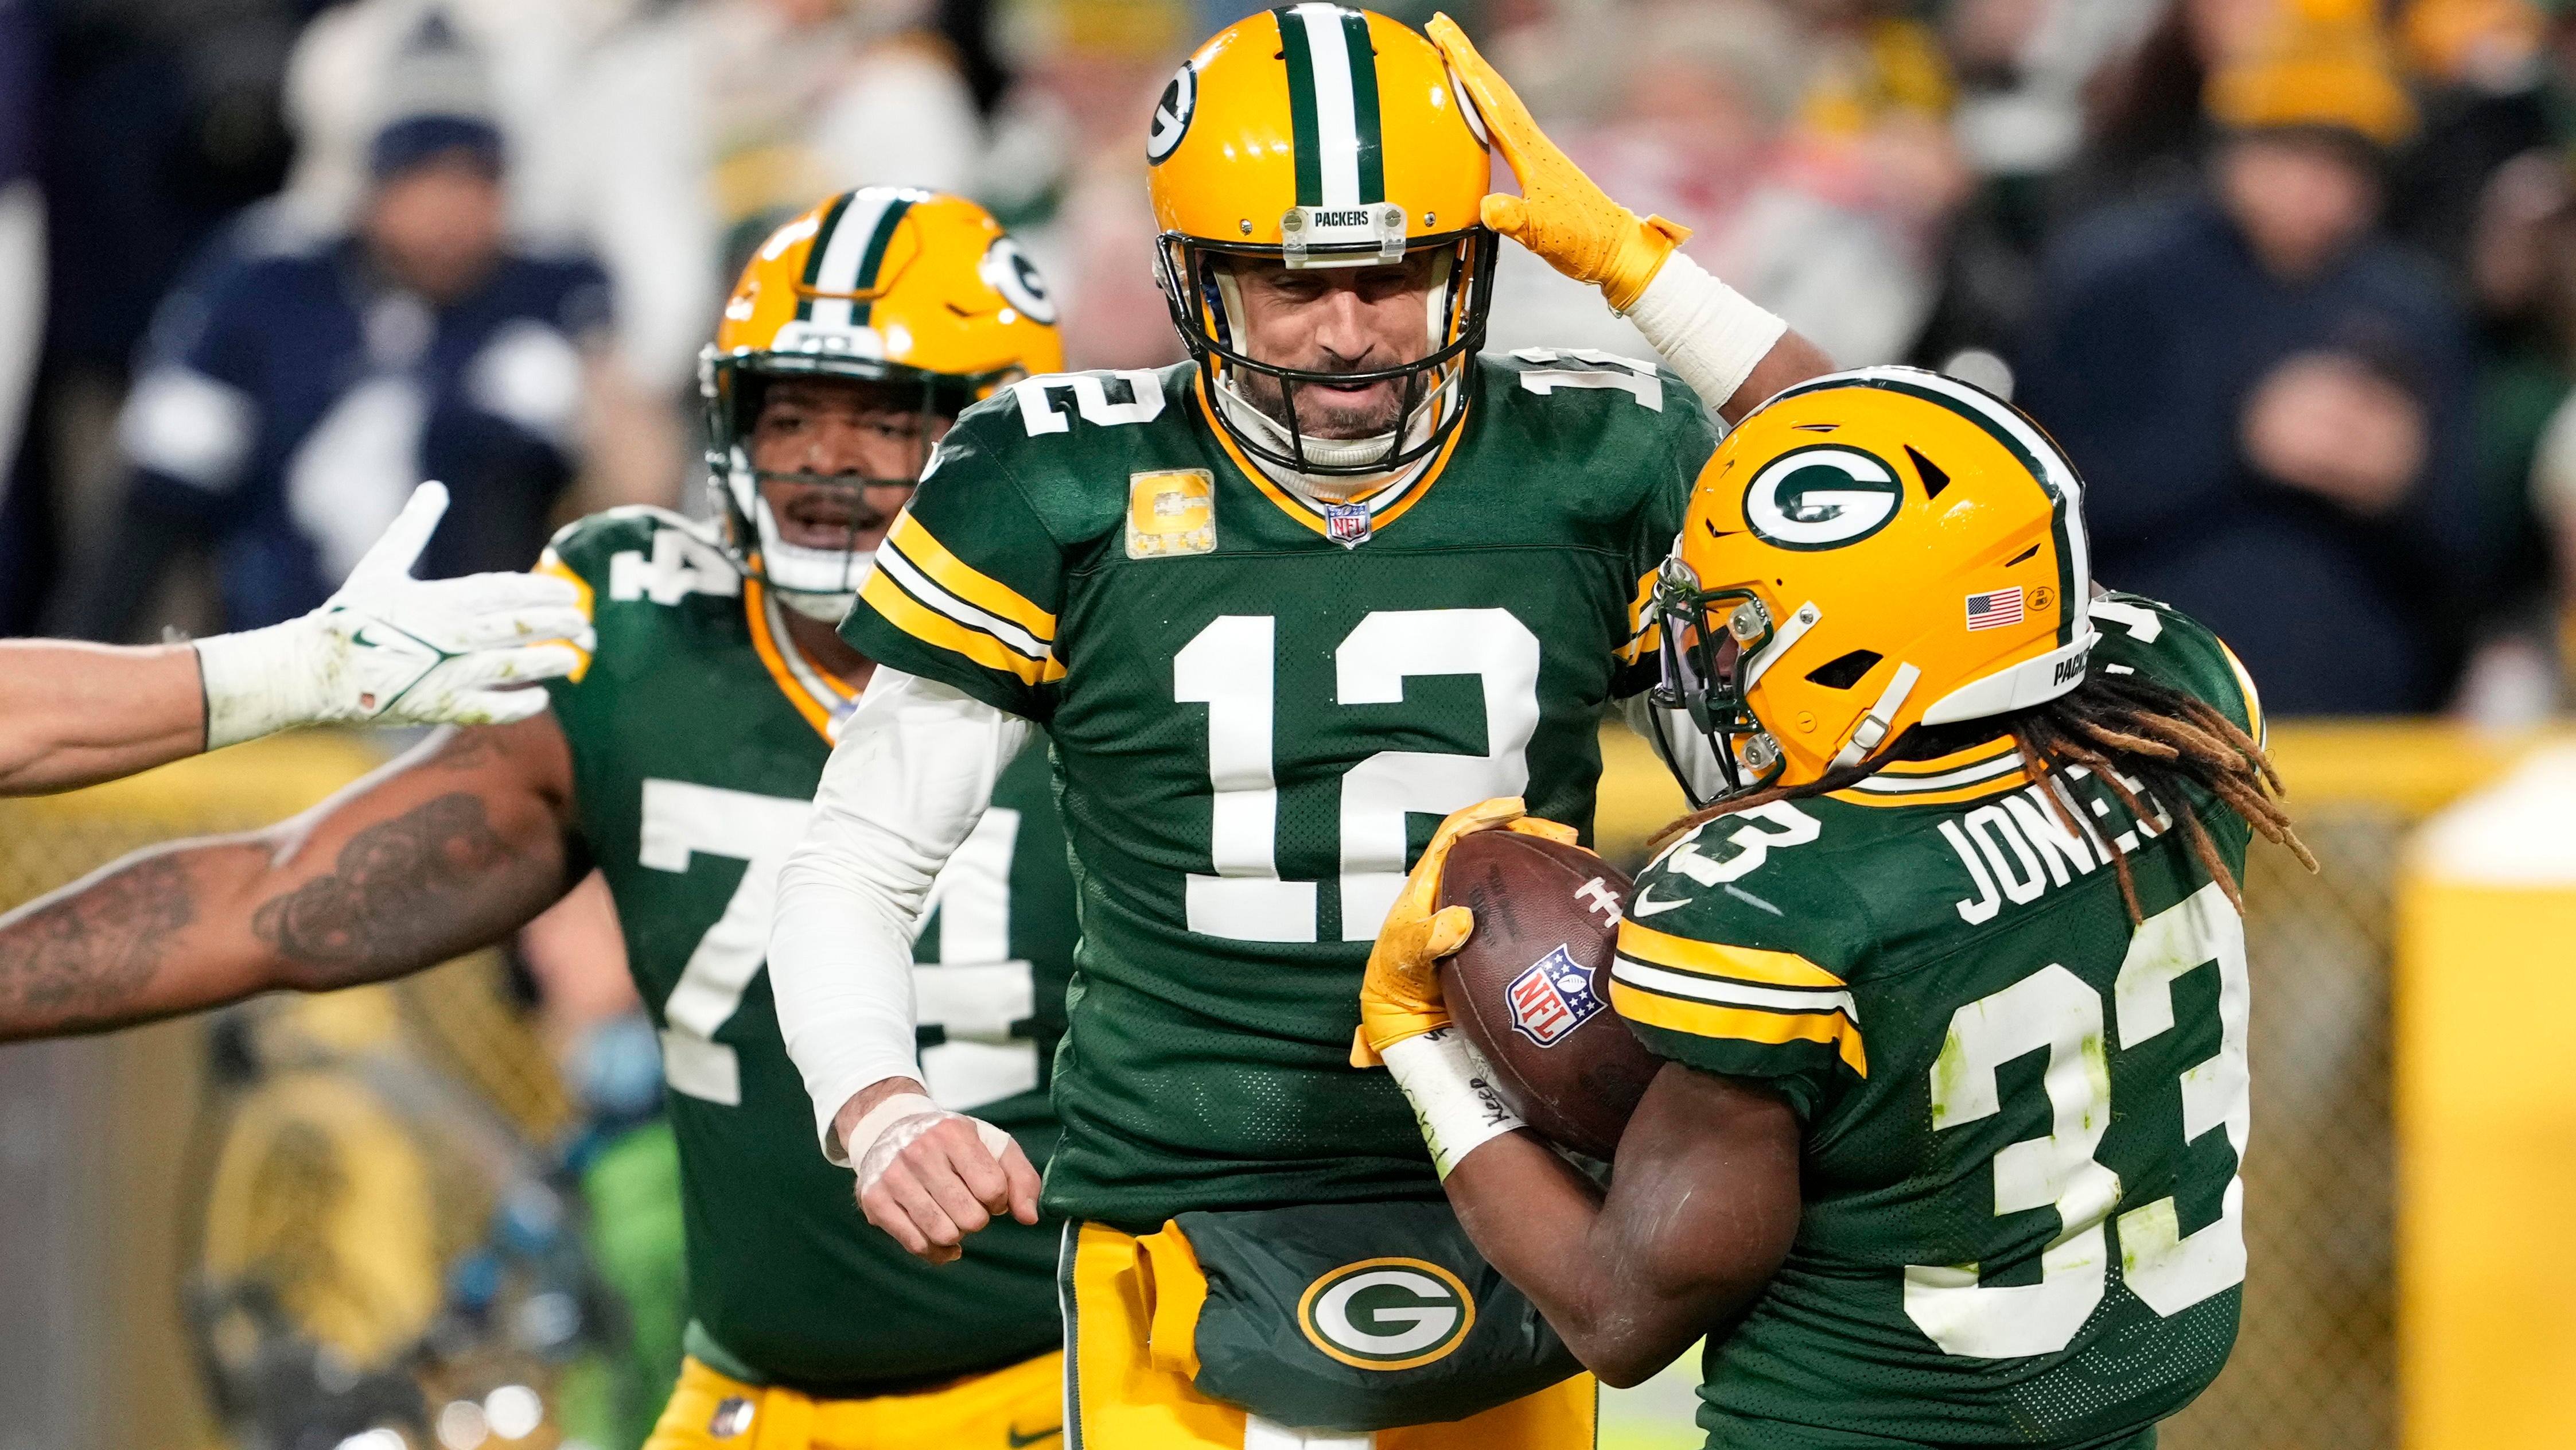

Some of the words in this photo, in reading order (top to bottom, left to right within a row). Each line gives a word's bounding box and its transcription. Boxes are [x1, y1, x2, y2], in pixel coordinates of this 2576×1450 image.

[1315, 211, 1369, 227] PACKERS
[1132, 474, 1209, 535] C
[1333, 518, 1365, 538] NFL
[1748, 449, 1896, 544] G
[1174, 607, 1540, 943] 12
[639, 778, 1038, 1111] 74
[1514, 973, 1568, 1039] NFL
[1904, 881, 2251, 1359] 33
[1315, 1270, 1457, 1355] G
